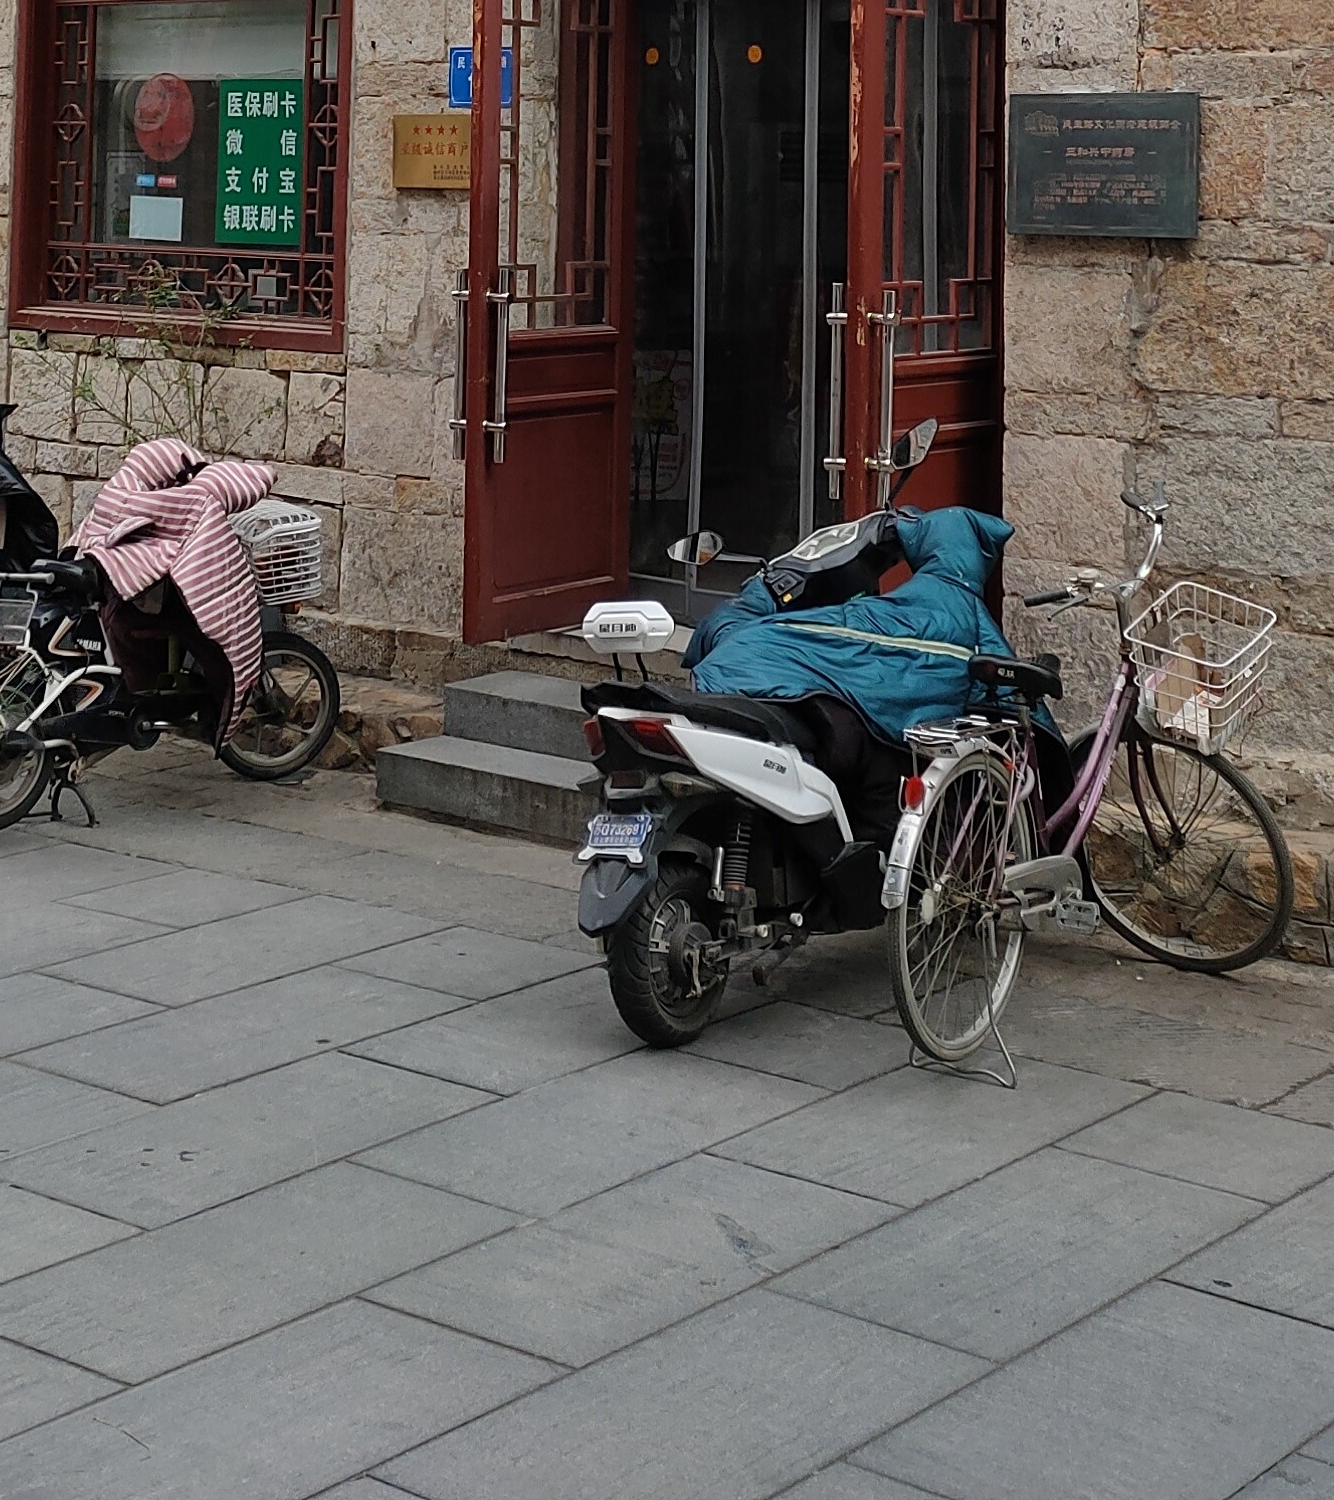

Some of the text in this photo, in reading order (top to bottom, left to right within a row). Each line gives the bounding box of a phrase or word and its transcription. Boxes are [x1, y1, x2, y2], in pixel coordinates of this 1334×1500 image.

[226, 91, 297, 119] 医保刷卡
[226, 129, 297, 157] 微信
[225, 166, 296, 195] 支付宝
[223, 204, 296, 233] 银联刷卡
